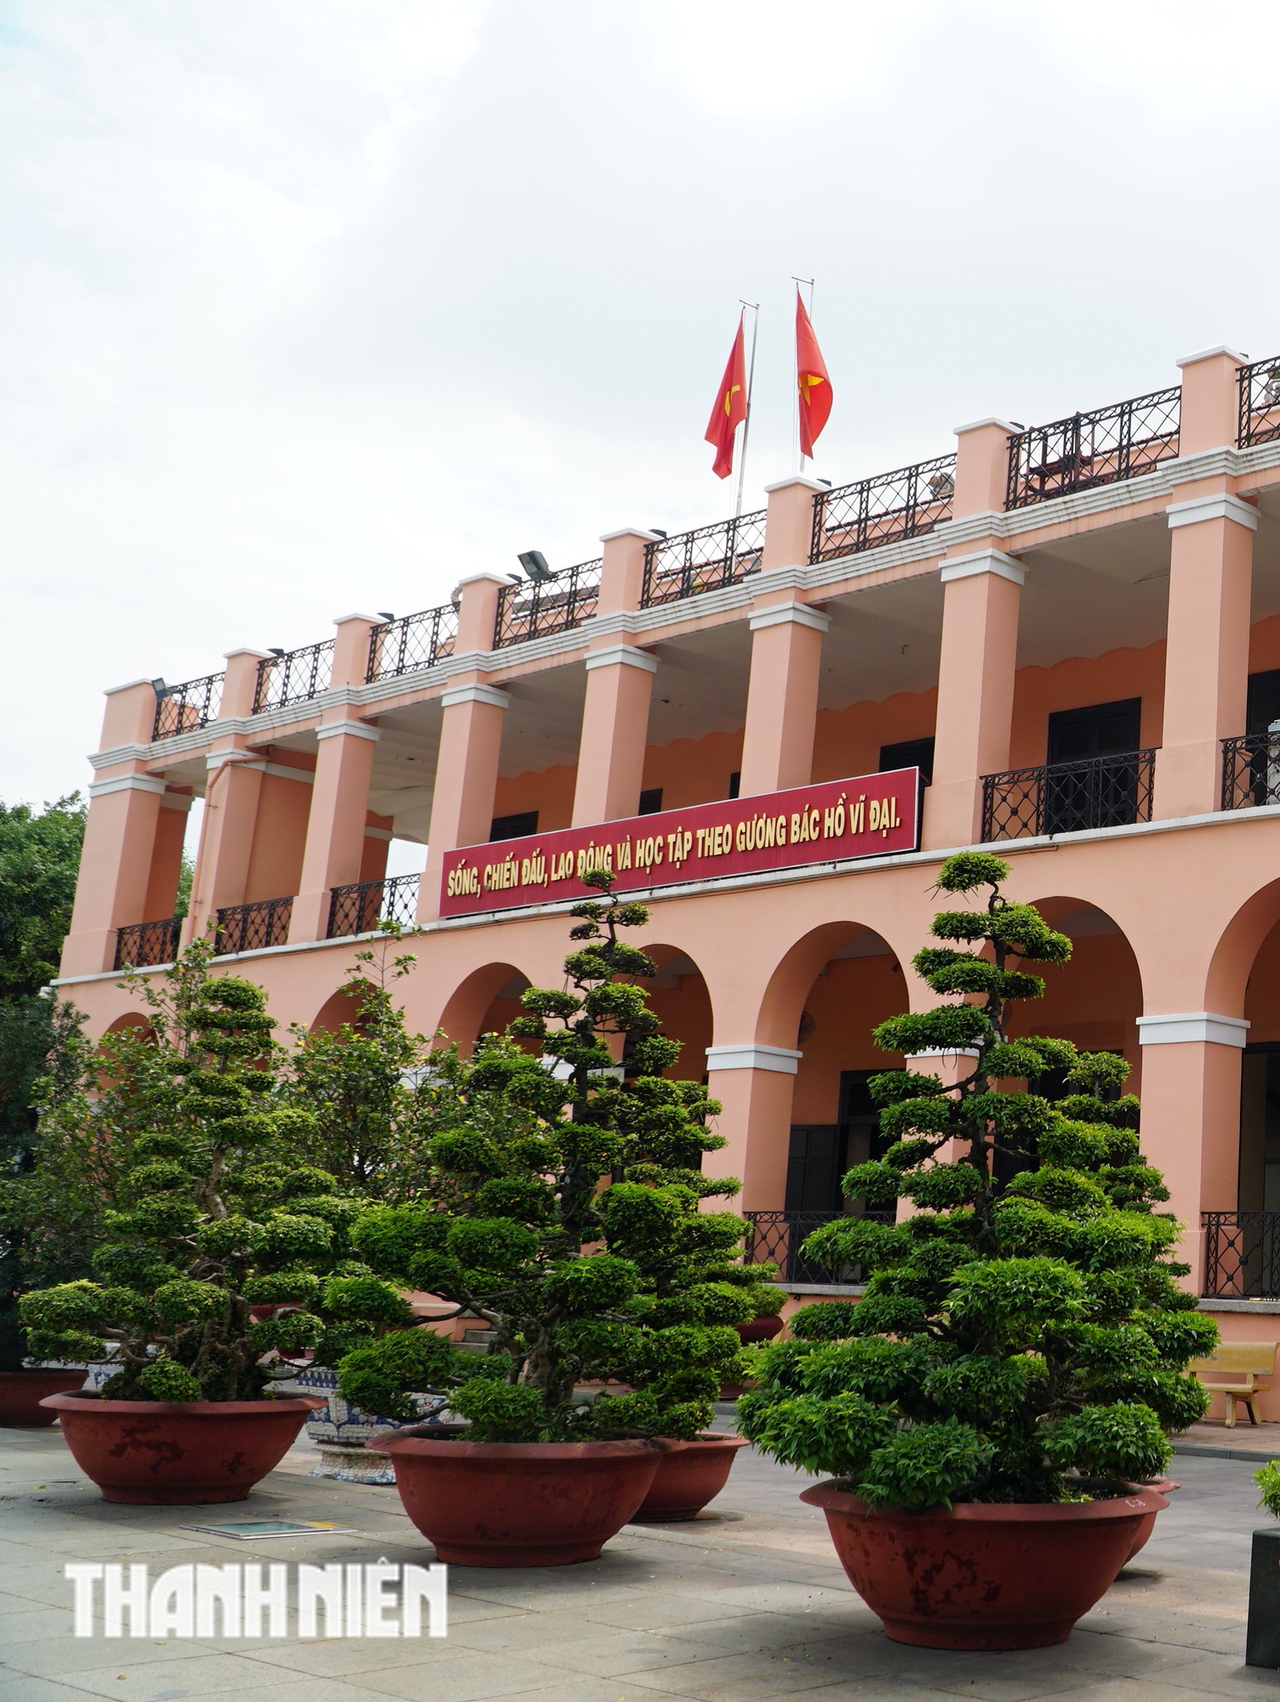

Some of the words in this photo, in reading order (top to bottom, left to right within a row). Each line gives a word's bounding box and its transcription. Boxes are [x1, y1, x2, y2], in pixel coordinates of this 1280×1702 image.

[447, 859, 481, 898] SỐNG,
[483, 852, 519, 891] CHIẾN
[521, 848, 548, 888] ĐẤU,
[550, 850, 574, 881] LAO
[616, 834, 632, 871] VÀ
[635, 835, 664, 874] HỌC
[667, 826, 693, 869] TẬP
[696, 824, 732, 858] THEO
[736, 812, 787, 852] GƯƠNG
[790, 804, 820, 844] BÁC
[824, 792, 847, 839] HỒ
[849, 794, 866, 835] VĨ
[869, 796, 901, 838] ĐẠI.
